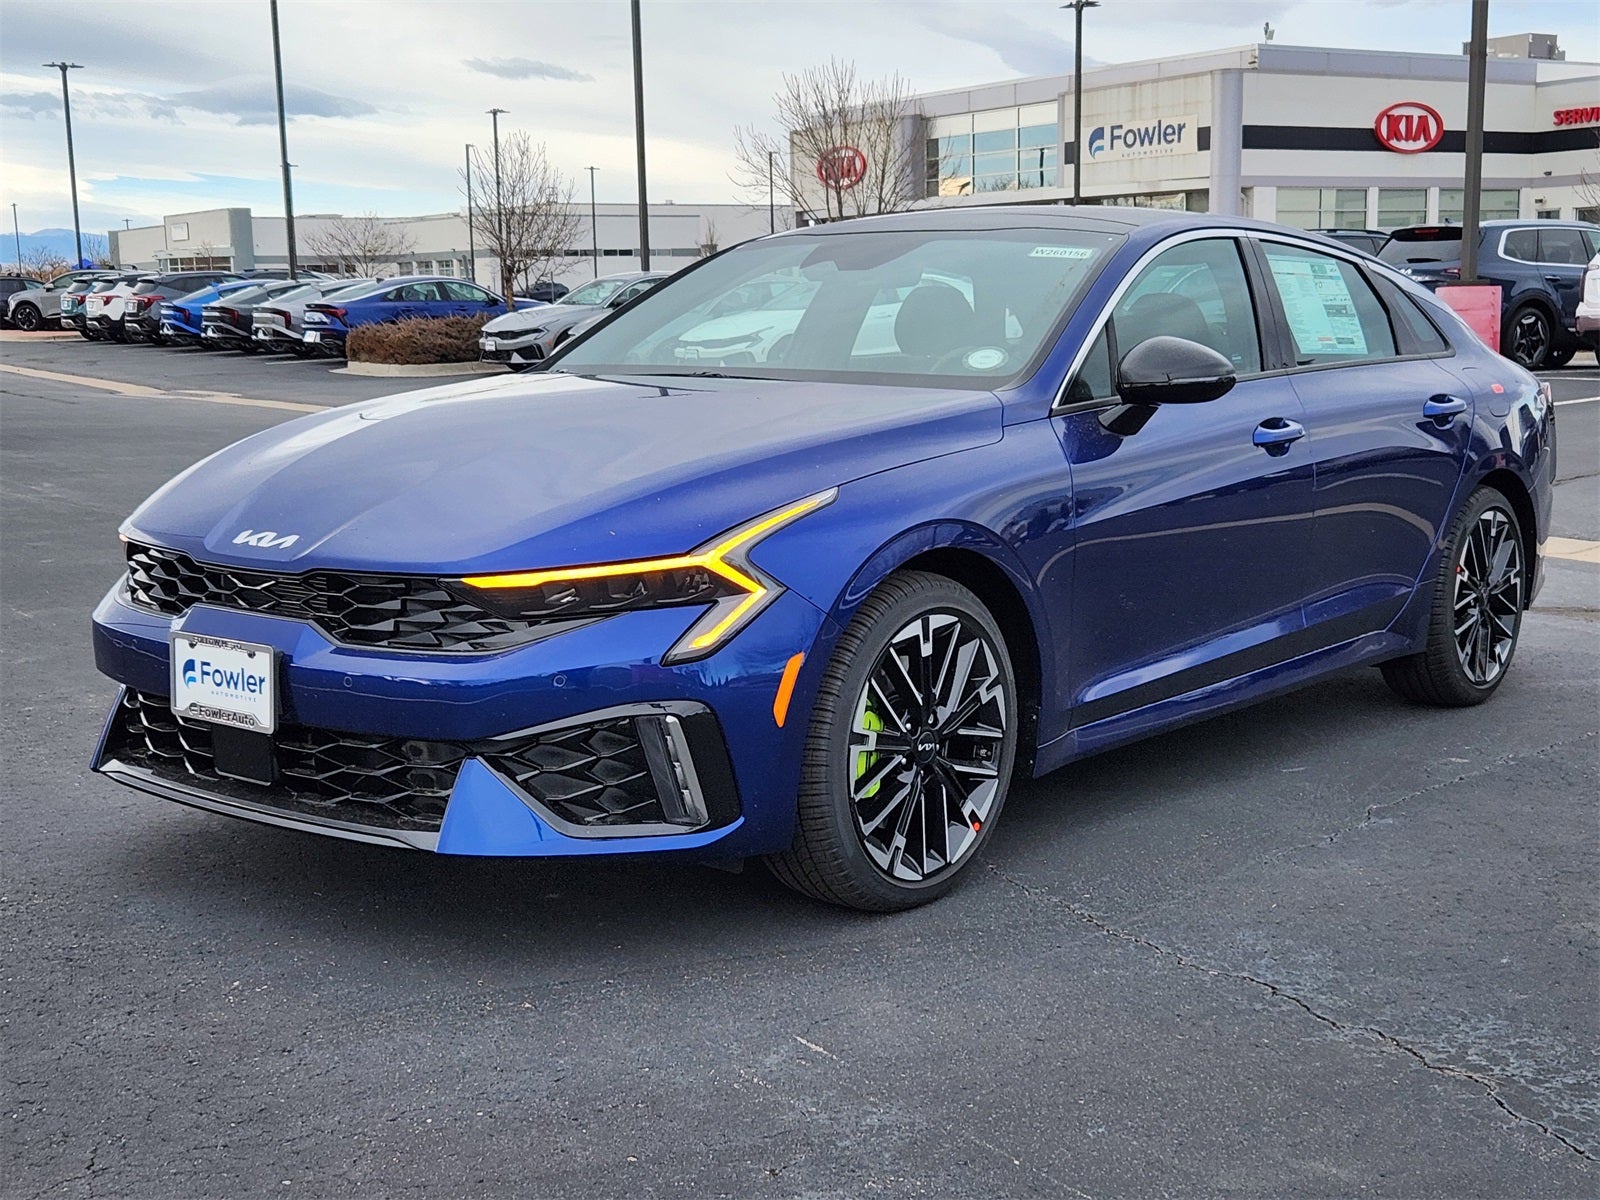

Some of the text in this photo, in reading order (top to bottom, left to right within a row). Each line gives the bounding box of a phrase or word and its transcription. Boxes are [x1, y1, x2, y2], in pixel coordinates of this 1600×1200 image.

[1109, 119, 1186, 151] Fowler
[1386, 114, 1433, 142] KIA
[1121, 148, 1174, 158] AUTOMOTIVE
[200, 660, 266, 695] Fowler
[211, 690, 257, 703] AUTOMOTIVE
[199, 705, 255, 728] FowlerAuto
